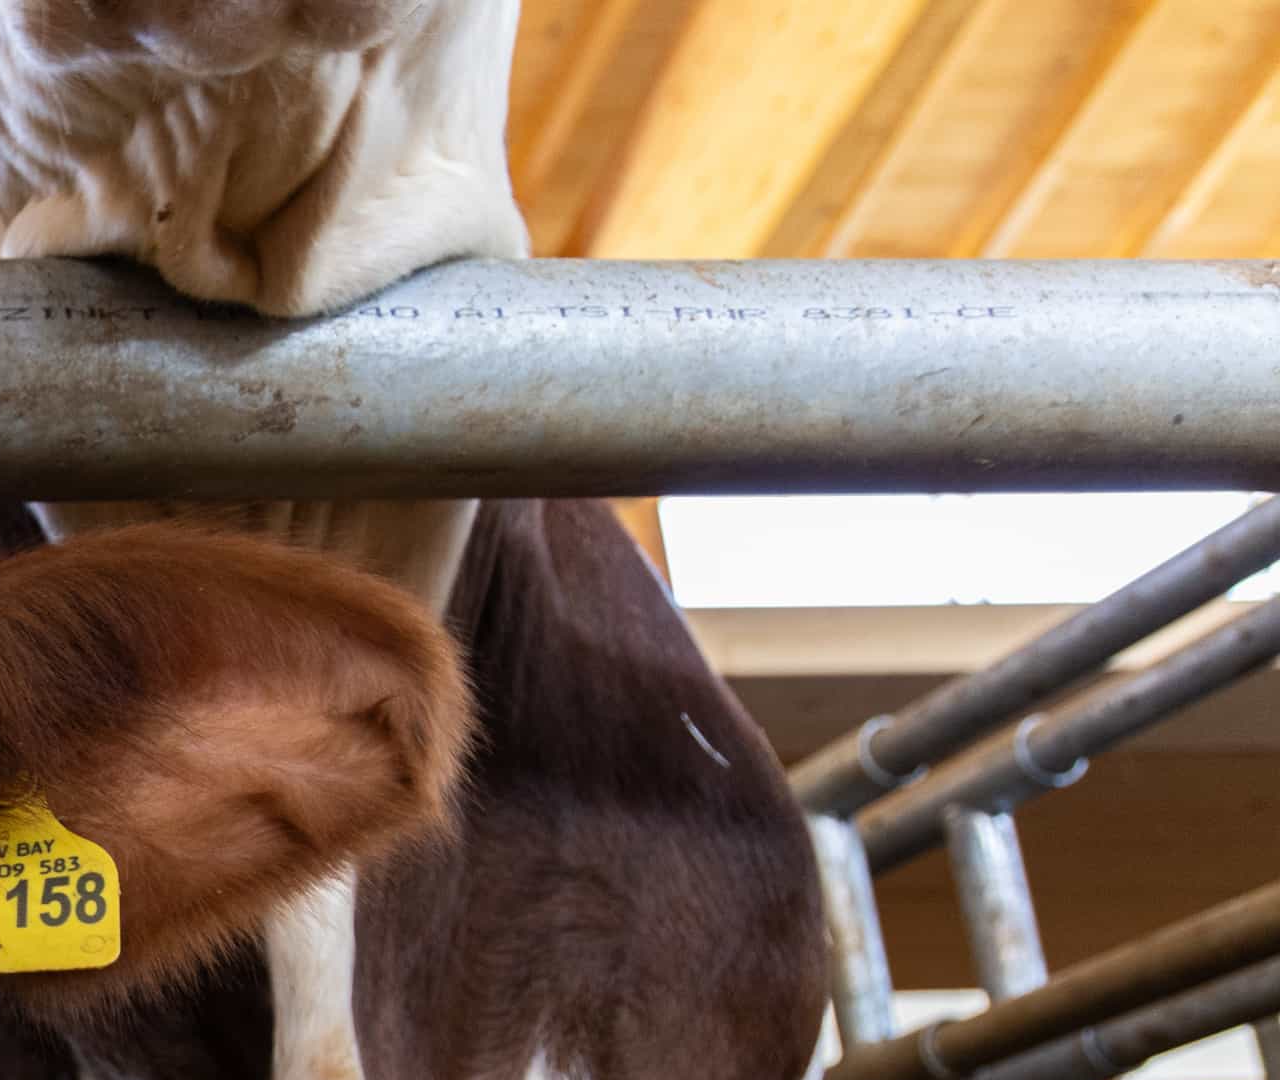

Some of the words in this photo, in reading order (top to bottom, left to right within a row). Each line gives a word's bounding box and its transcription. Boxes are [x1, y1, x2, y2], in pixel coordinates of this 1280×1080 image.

[16, 839, 56, 857] BAY
[39, 856, 81, 875] 583
[5, 872, 108, 928] 158
